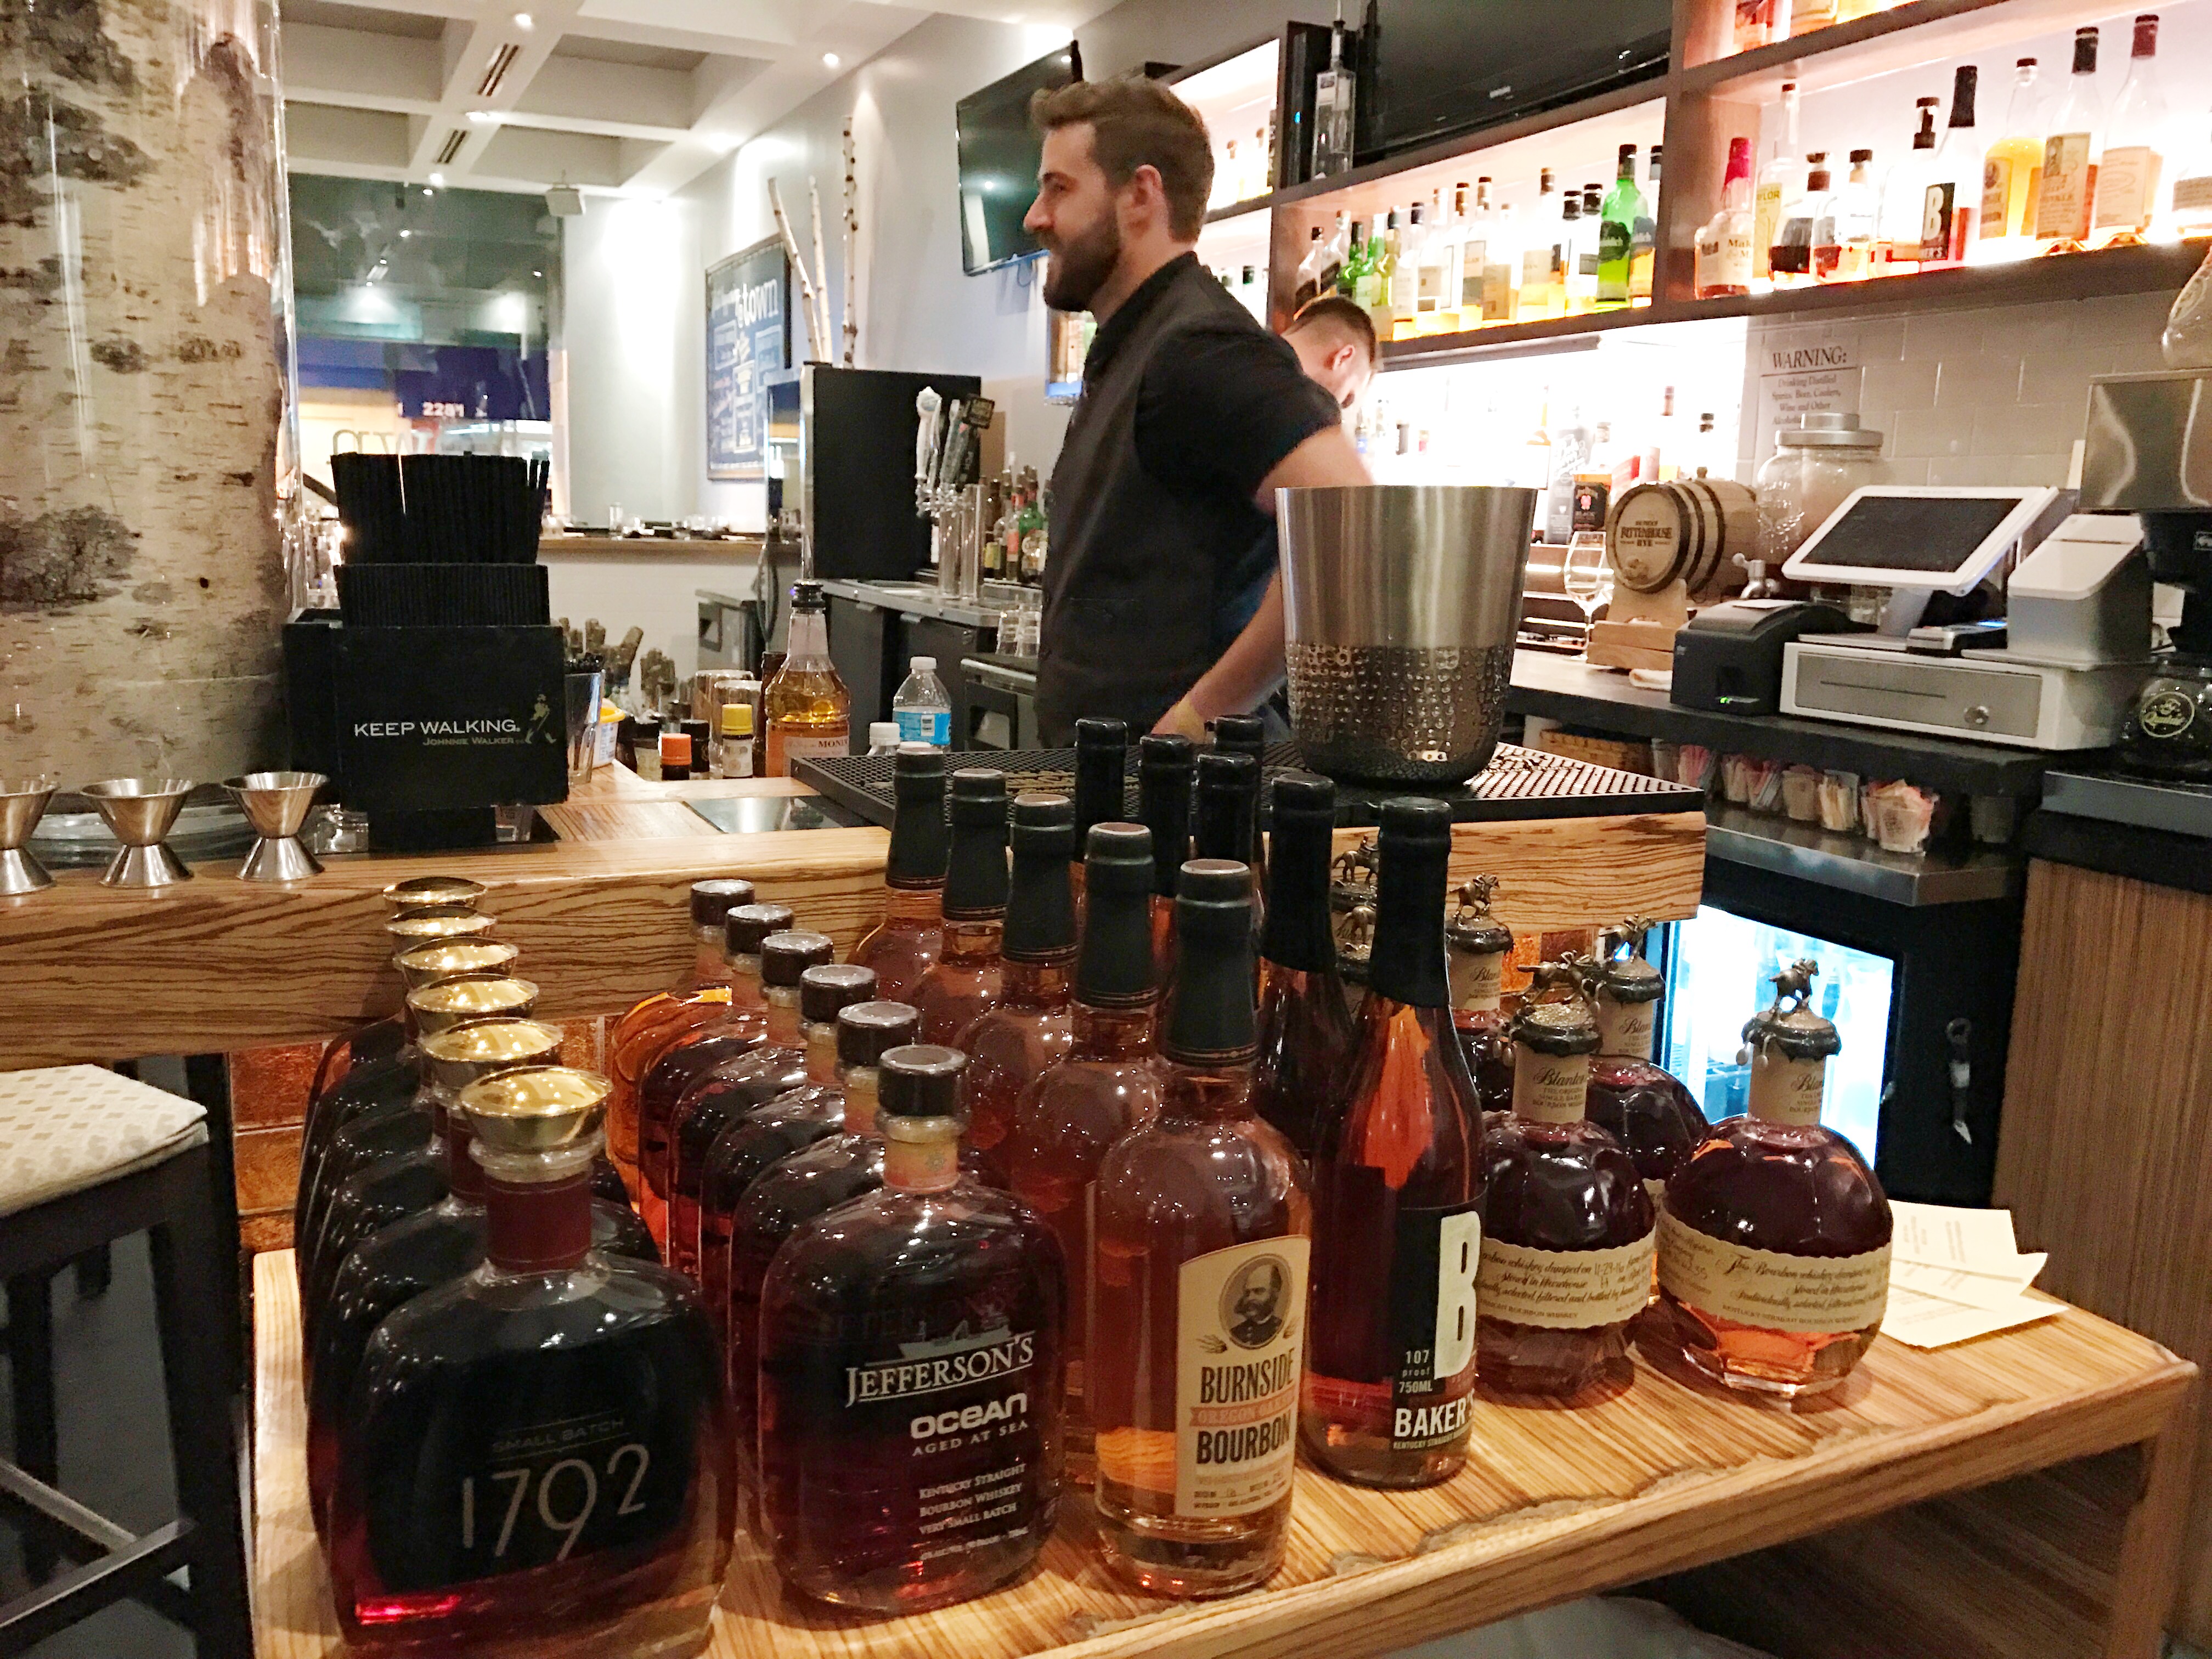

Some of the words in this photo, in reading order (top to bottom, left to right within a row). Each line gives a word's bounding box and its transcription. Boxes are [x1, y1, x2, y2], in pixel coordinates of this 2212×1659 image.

[1922, 187, 1944, 241] B
[1773, 346, 1847, 369] WARNING:
[354, 721, 415, 737] KEEP
[420, 718, 521, 735] WALKING.
[422, 737, 469, 746] JOHNNIE
[471, 736, 515, 745] WALKER
[1434, 1210, 1481, 1379] B
[844, 1335, 1034, 1408] JEFFERSON'S
[1402, 1367, 1430, 1378] proof
[1406, 1349, 1430, 1364] 107
[1200, 1347, 1295, 1404] BURNSIDE
[1399, 1380, 1434, 1394] 750ML
[912, 1438, 962, 1457] AGED
[969, 1430, 991, 1444] AT
[998, 1420, 1029, 1436] SEA
[1195, 1409, 1291, 1464] BOURBON
[919, 1479, 973, 1499] KENTUCKY
[974, 1463, 1027, 1486] STRAIGHT
[462, 1443, 651, 1562] 1792
[919, 1497, 973, 1517] BOURBON
[975, 1482, 1024, 1503] WHISKEY
[983, 1502, 1017, 1520] BATCH
